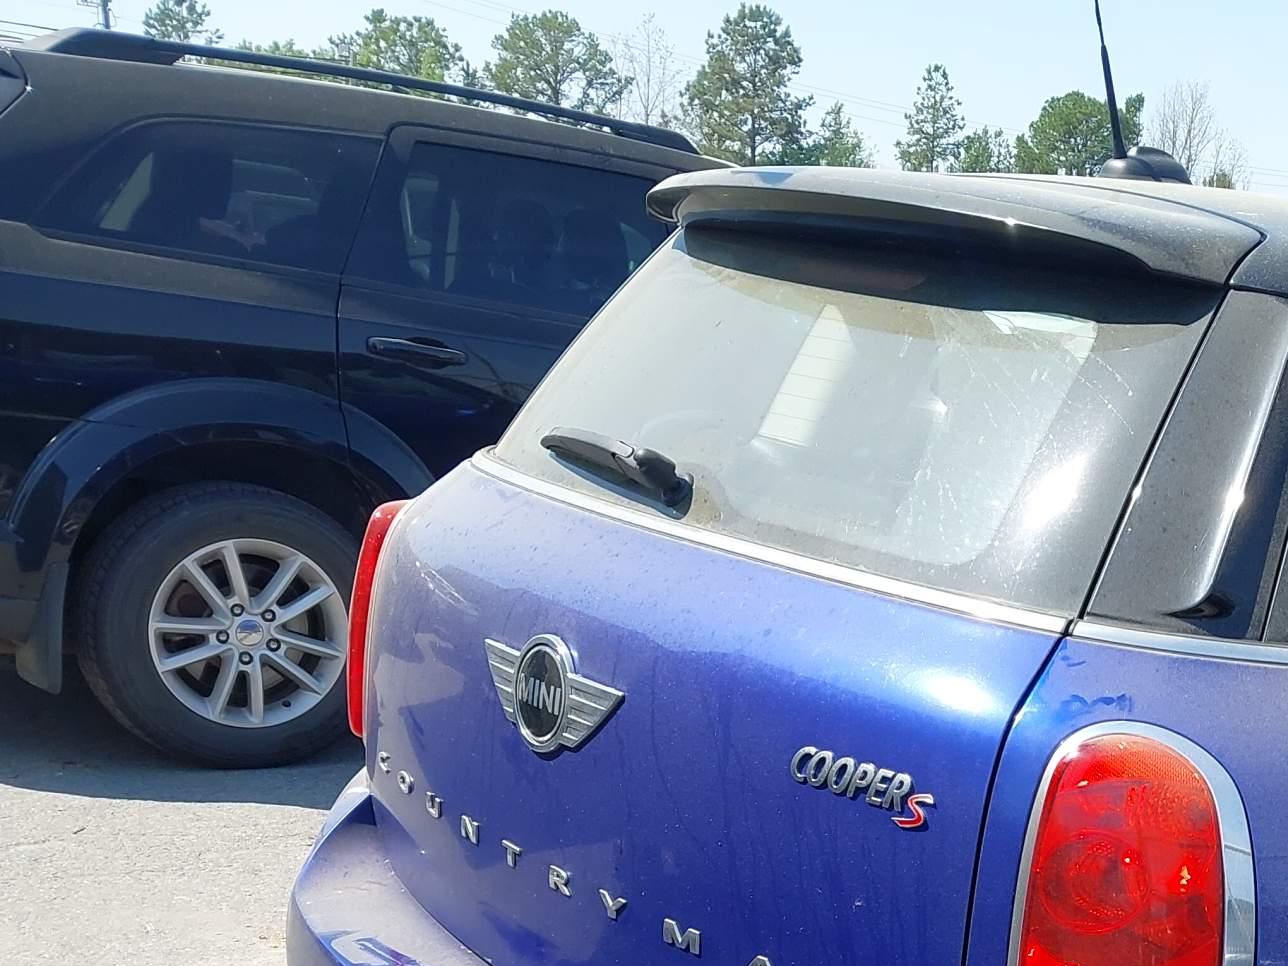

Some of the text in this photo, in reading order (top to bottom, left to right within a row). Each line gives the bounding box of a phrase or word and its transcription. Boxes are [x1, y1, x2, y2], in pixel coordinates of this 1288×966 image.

[519, 672, 562, 716] MINI
[790, 746, 934, 828] COOPER S
